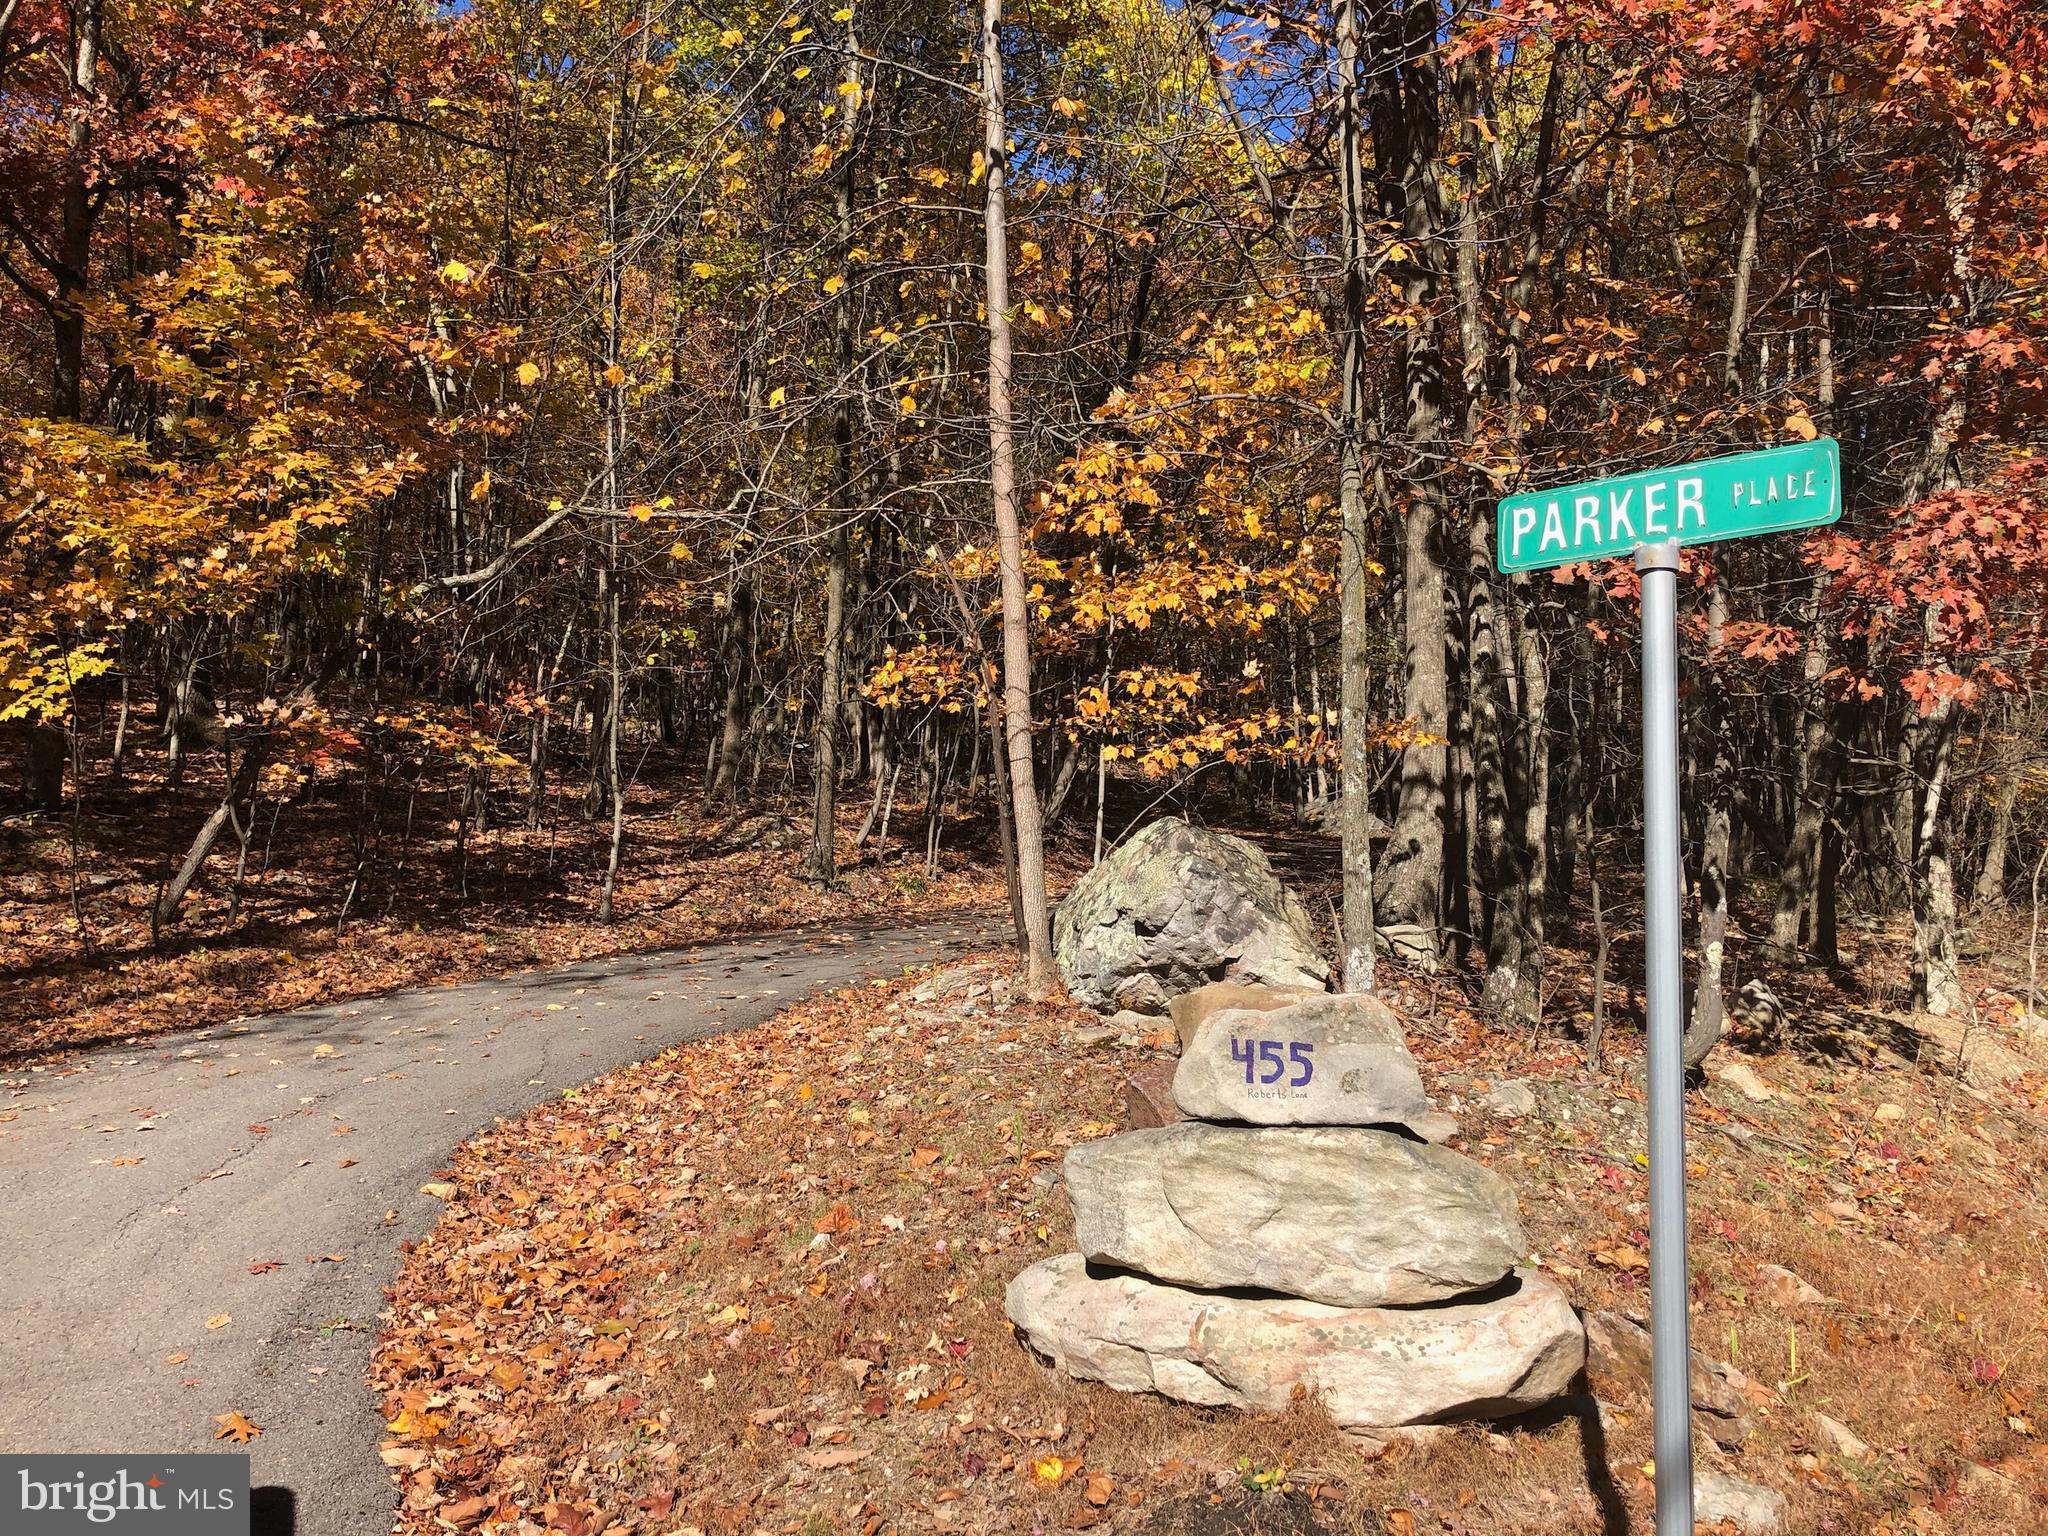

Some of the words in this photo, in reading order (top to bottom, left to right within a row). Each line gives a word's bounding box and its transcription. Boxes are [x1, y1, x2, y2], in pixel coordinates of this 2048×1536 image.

[1511, 478, 1707, 558] PARKER
[1733, 470, 1817, 509] PLACE
[1231, 1038, 1314, 1087] 455
[1247, 1088, 1287, 1099] Roberts
